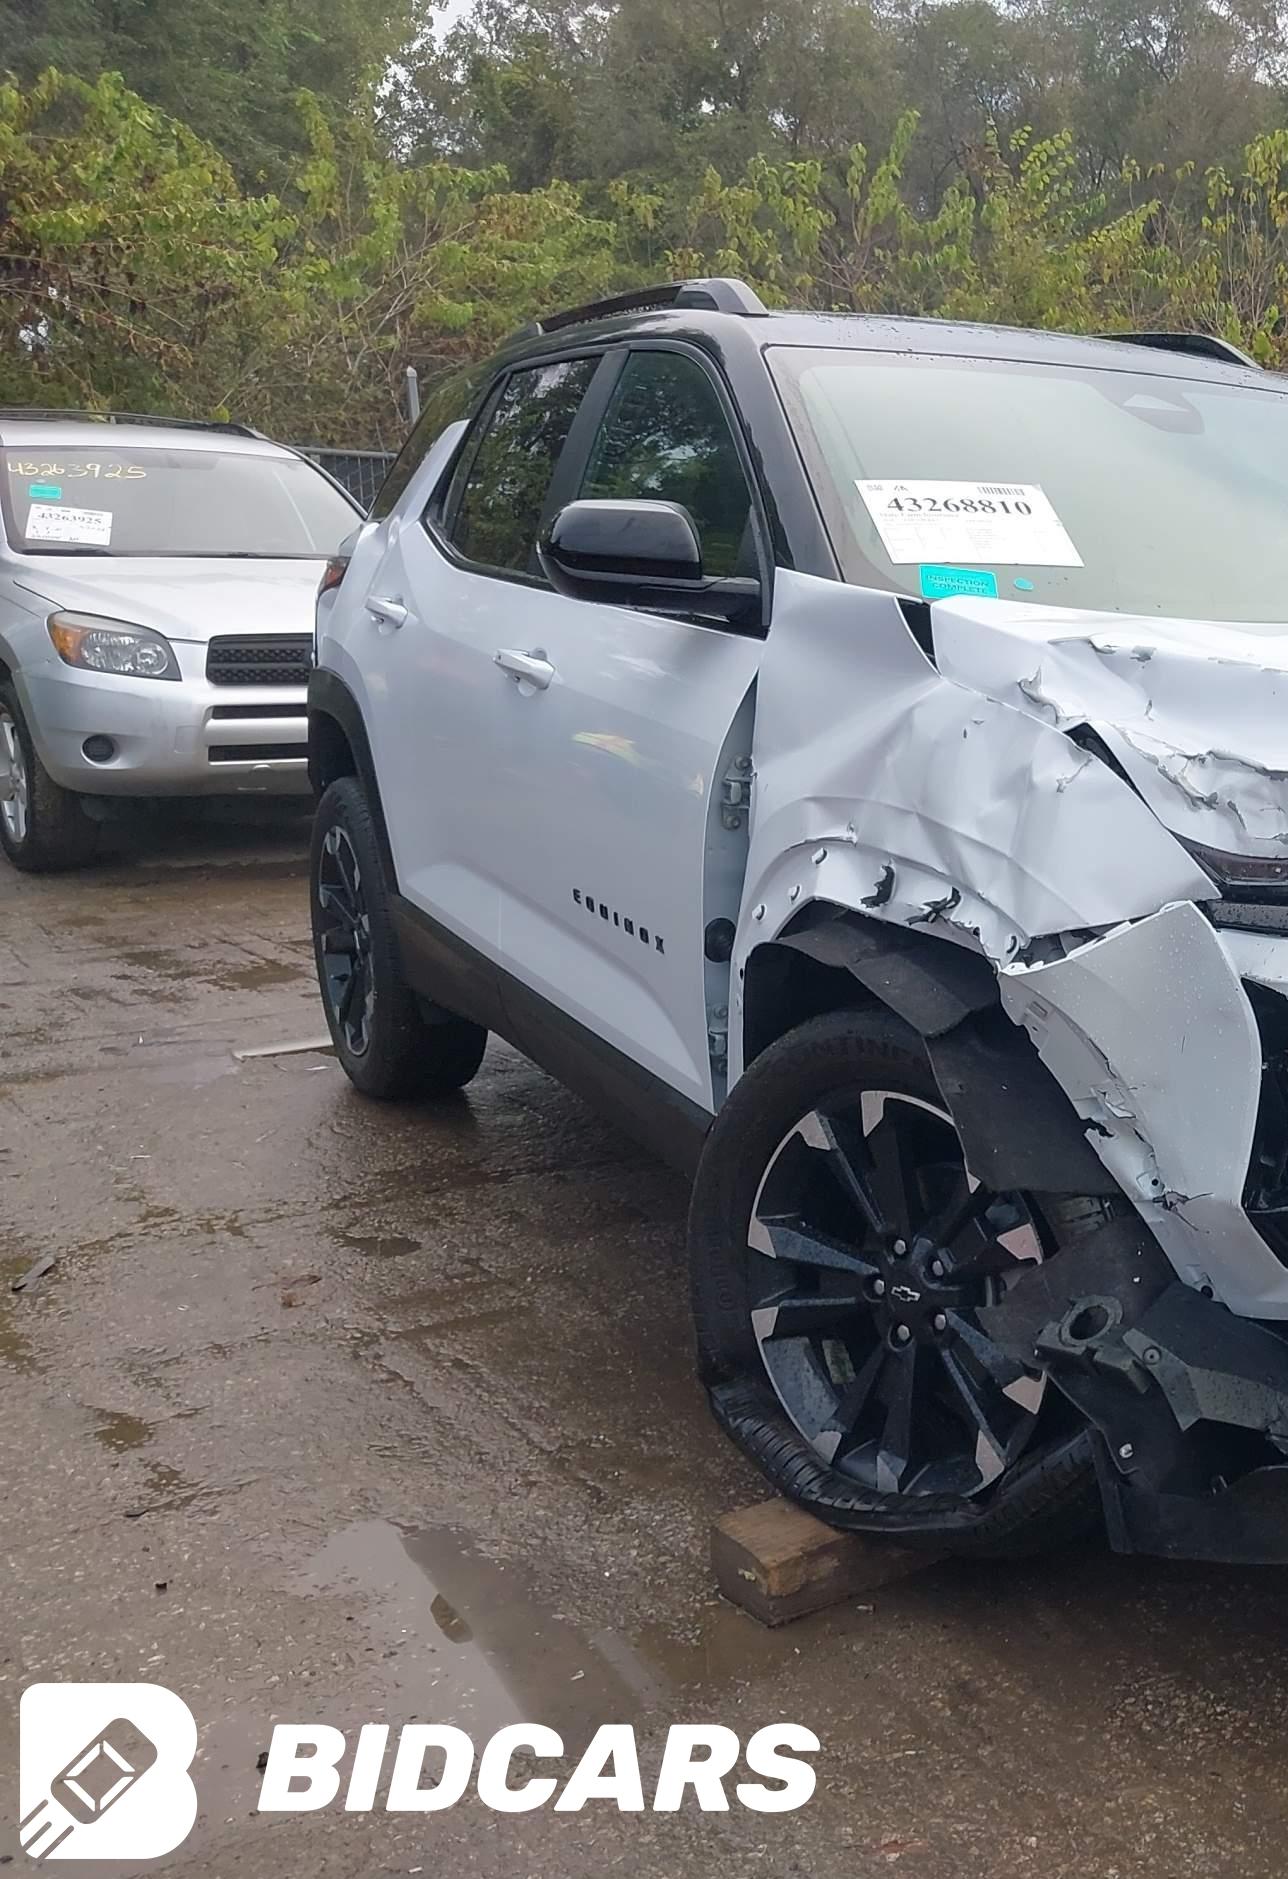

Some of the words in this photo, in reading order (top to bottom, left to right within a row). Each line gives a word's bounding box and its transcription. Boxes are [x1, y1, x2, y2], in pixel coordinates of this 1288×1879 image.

[7, 461, 147, 479] 43263925
[887, 496, 1032, 516] 43268810
[926, 574, 990, 587] INSPECTION
[932, 582, 988, 594] COMPLETE
[572, 888, 664, 954] EQUINOX
